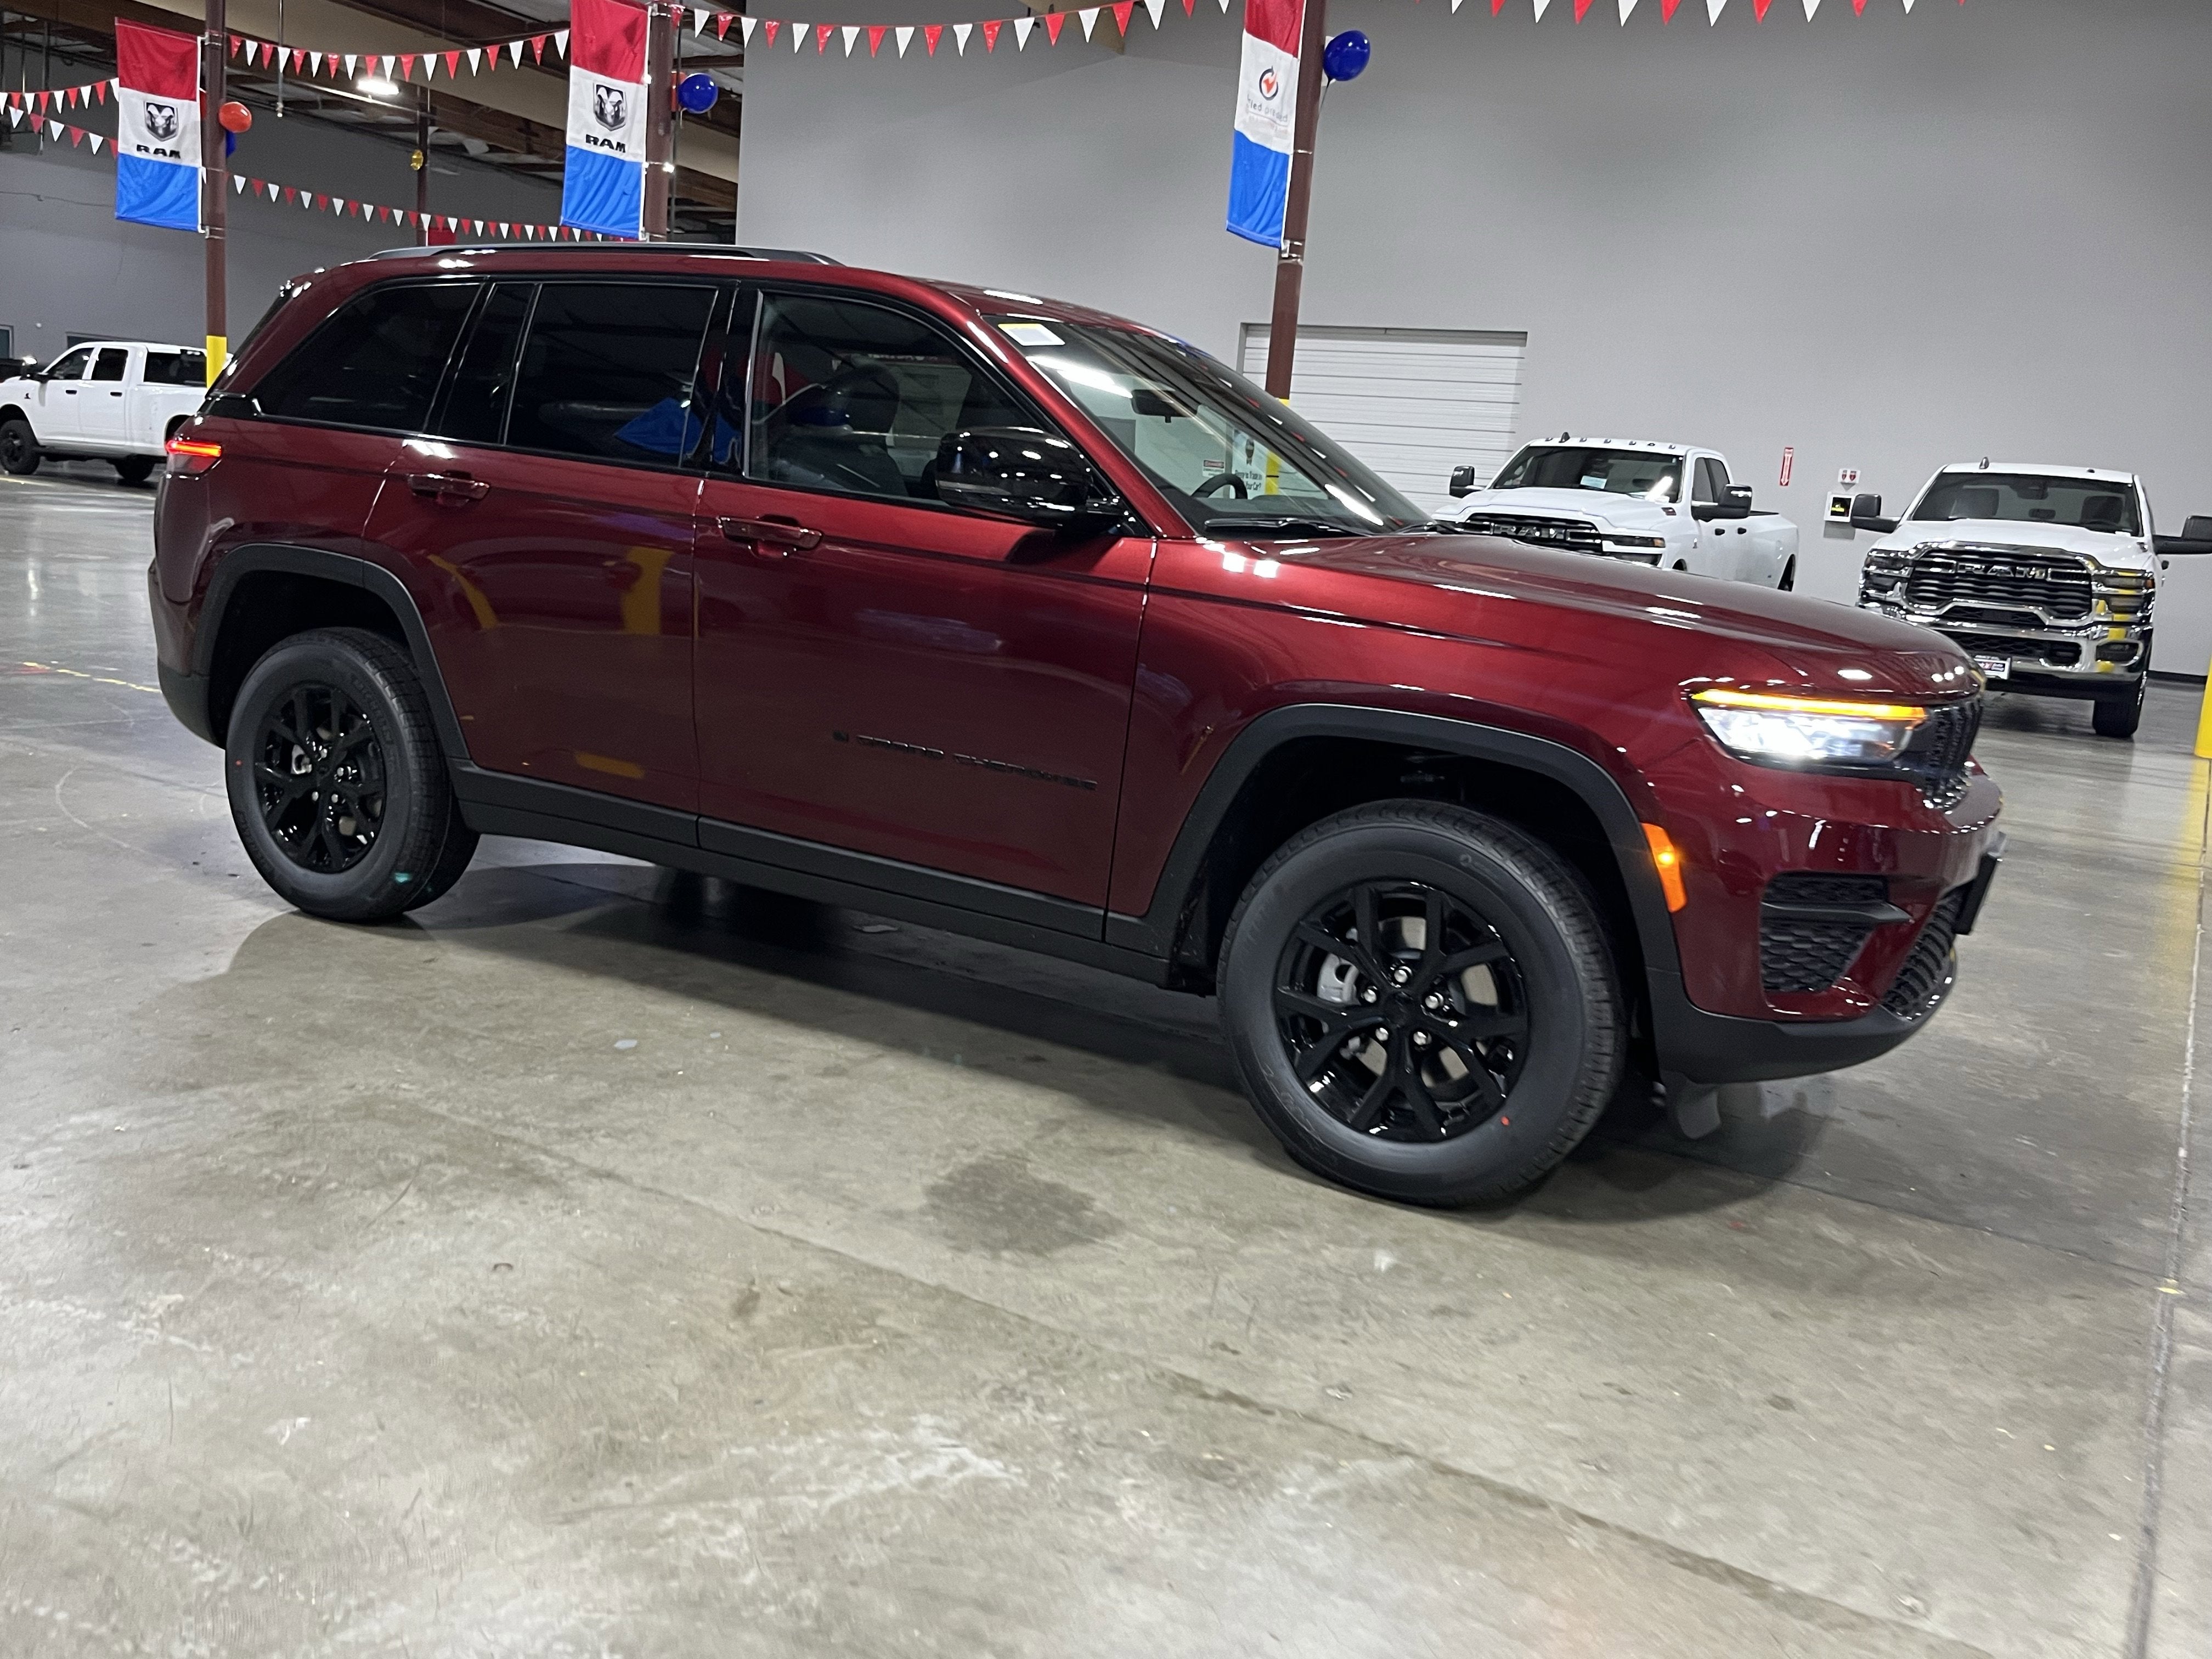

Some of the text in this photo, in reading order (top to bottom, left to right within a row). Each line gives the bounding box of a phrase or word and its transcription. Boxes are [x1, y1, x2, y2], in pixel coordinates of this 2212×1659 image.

[136, 144, 181, 159] RAM
[586, 134, 626, 153] RAM
[1493, 524, 1566, 539] RAM
[1957, 562, 2046, 579] RAM
